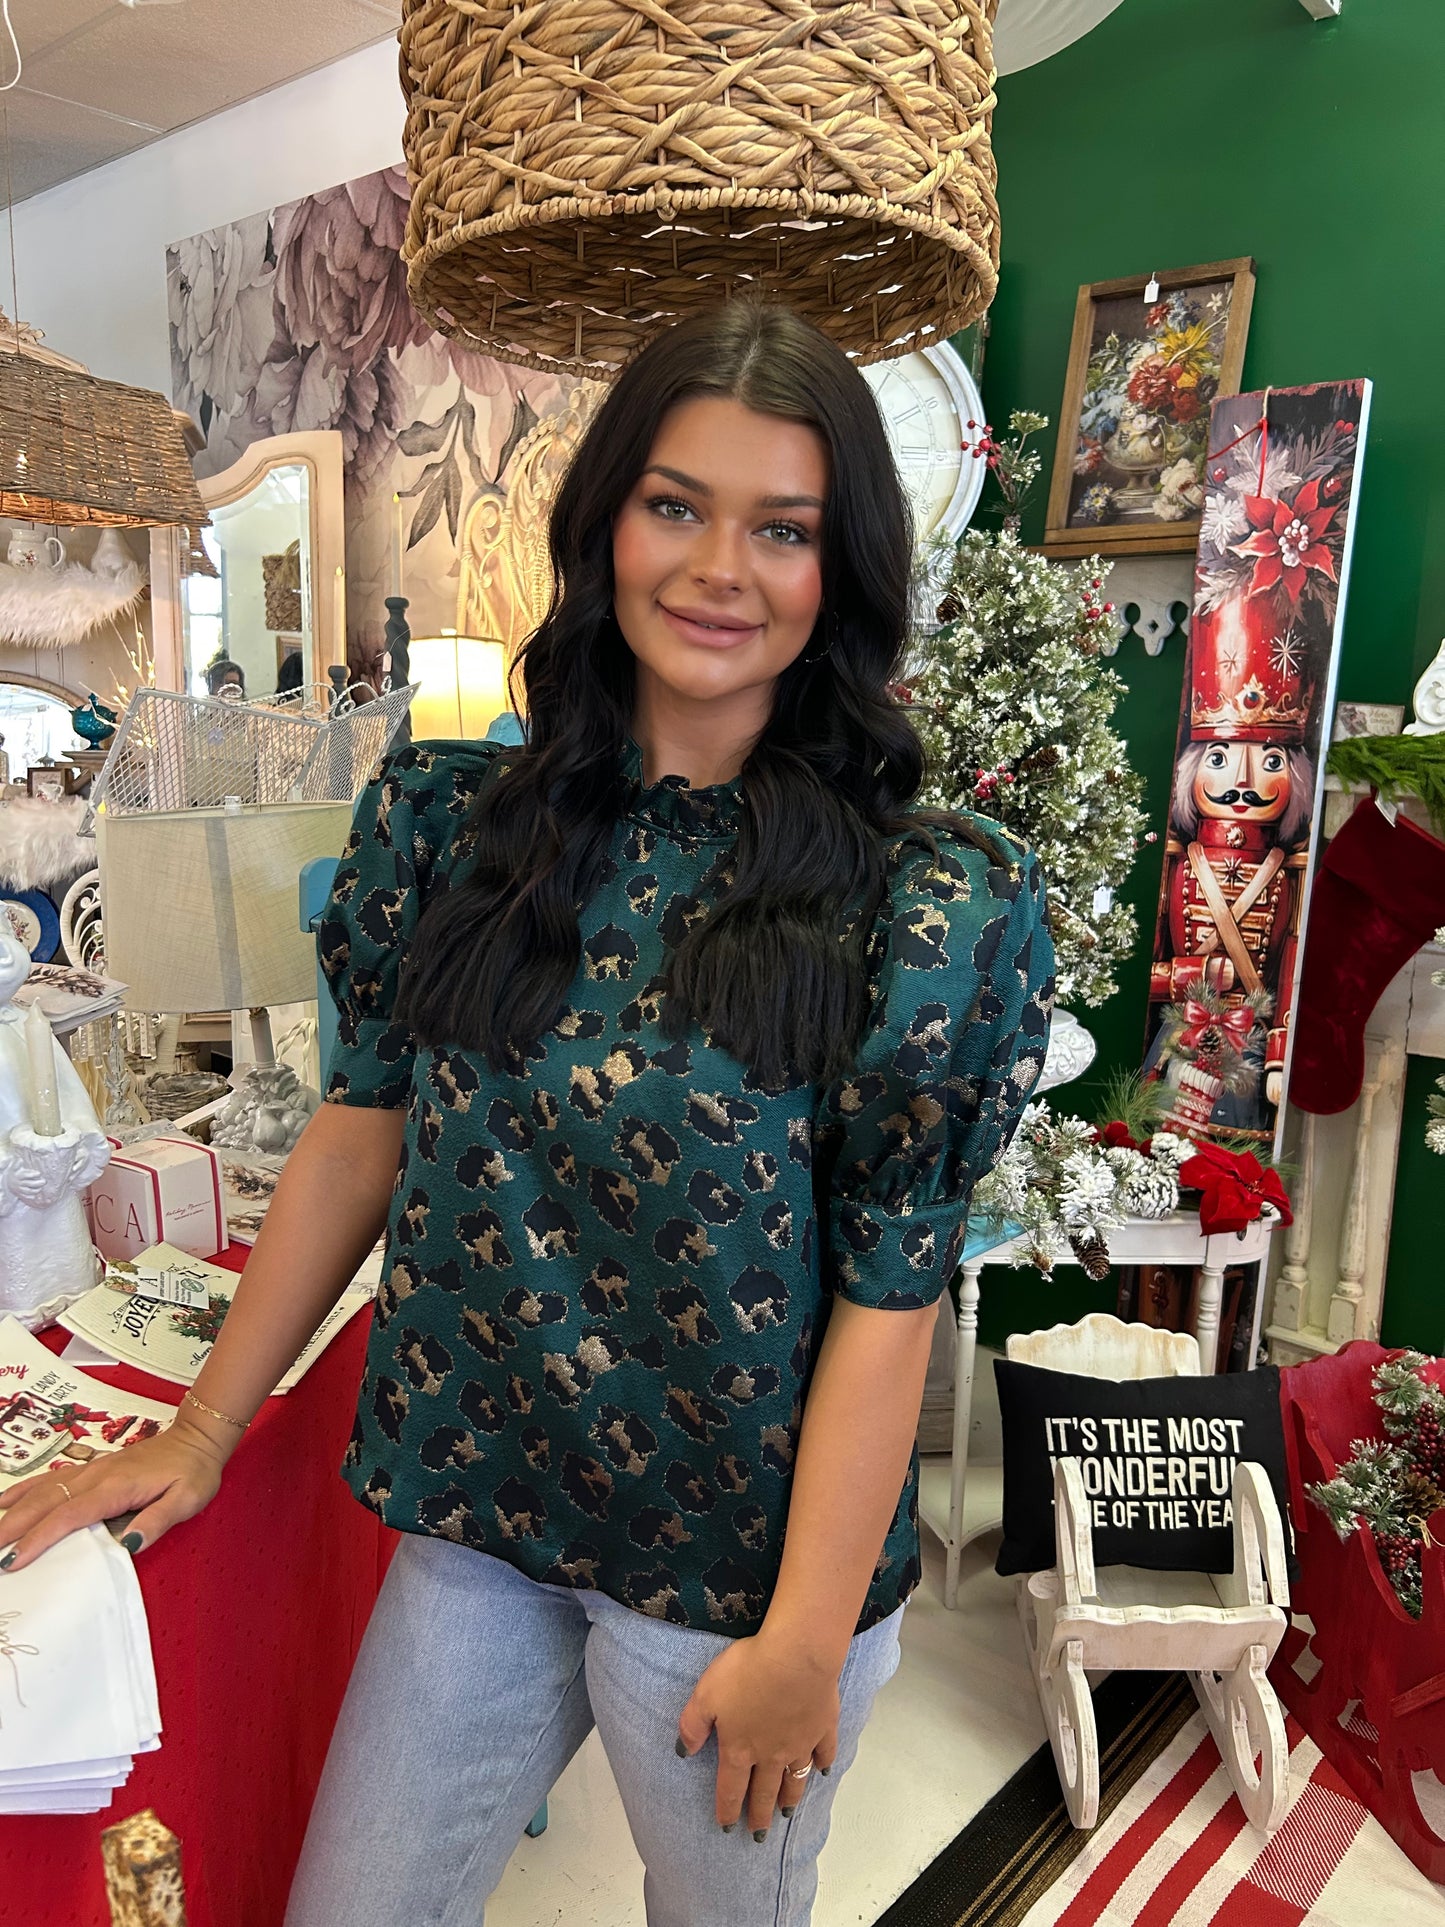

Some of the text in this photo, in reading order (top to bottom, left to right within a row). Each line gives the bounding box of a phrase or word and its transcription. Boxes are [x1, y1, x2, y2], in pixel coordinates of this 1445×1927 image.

[30, 1371, 61, 1393] CANDY
[47, 1382, 78, 1401] TARTS
[1045, 1417, 1244, 1453] IT'S THE MOST
[1112, 1501, 1140, 1528] OF
[1142, 1501, 1190, 1530] THE
[1190, 1499, 1233, 1528] YEA
